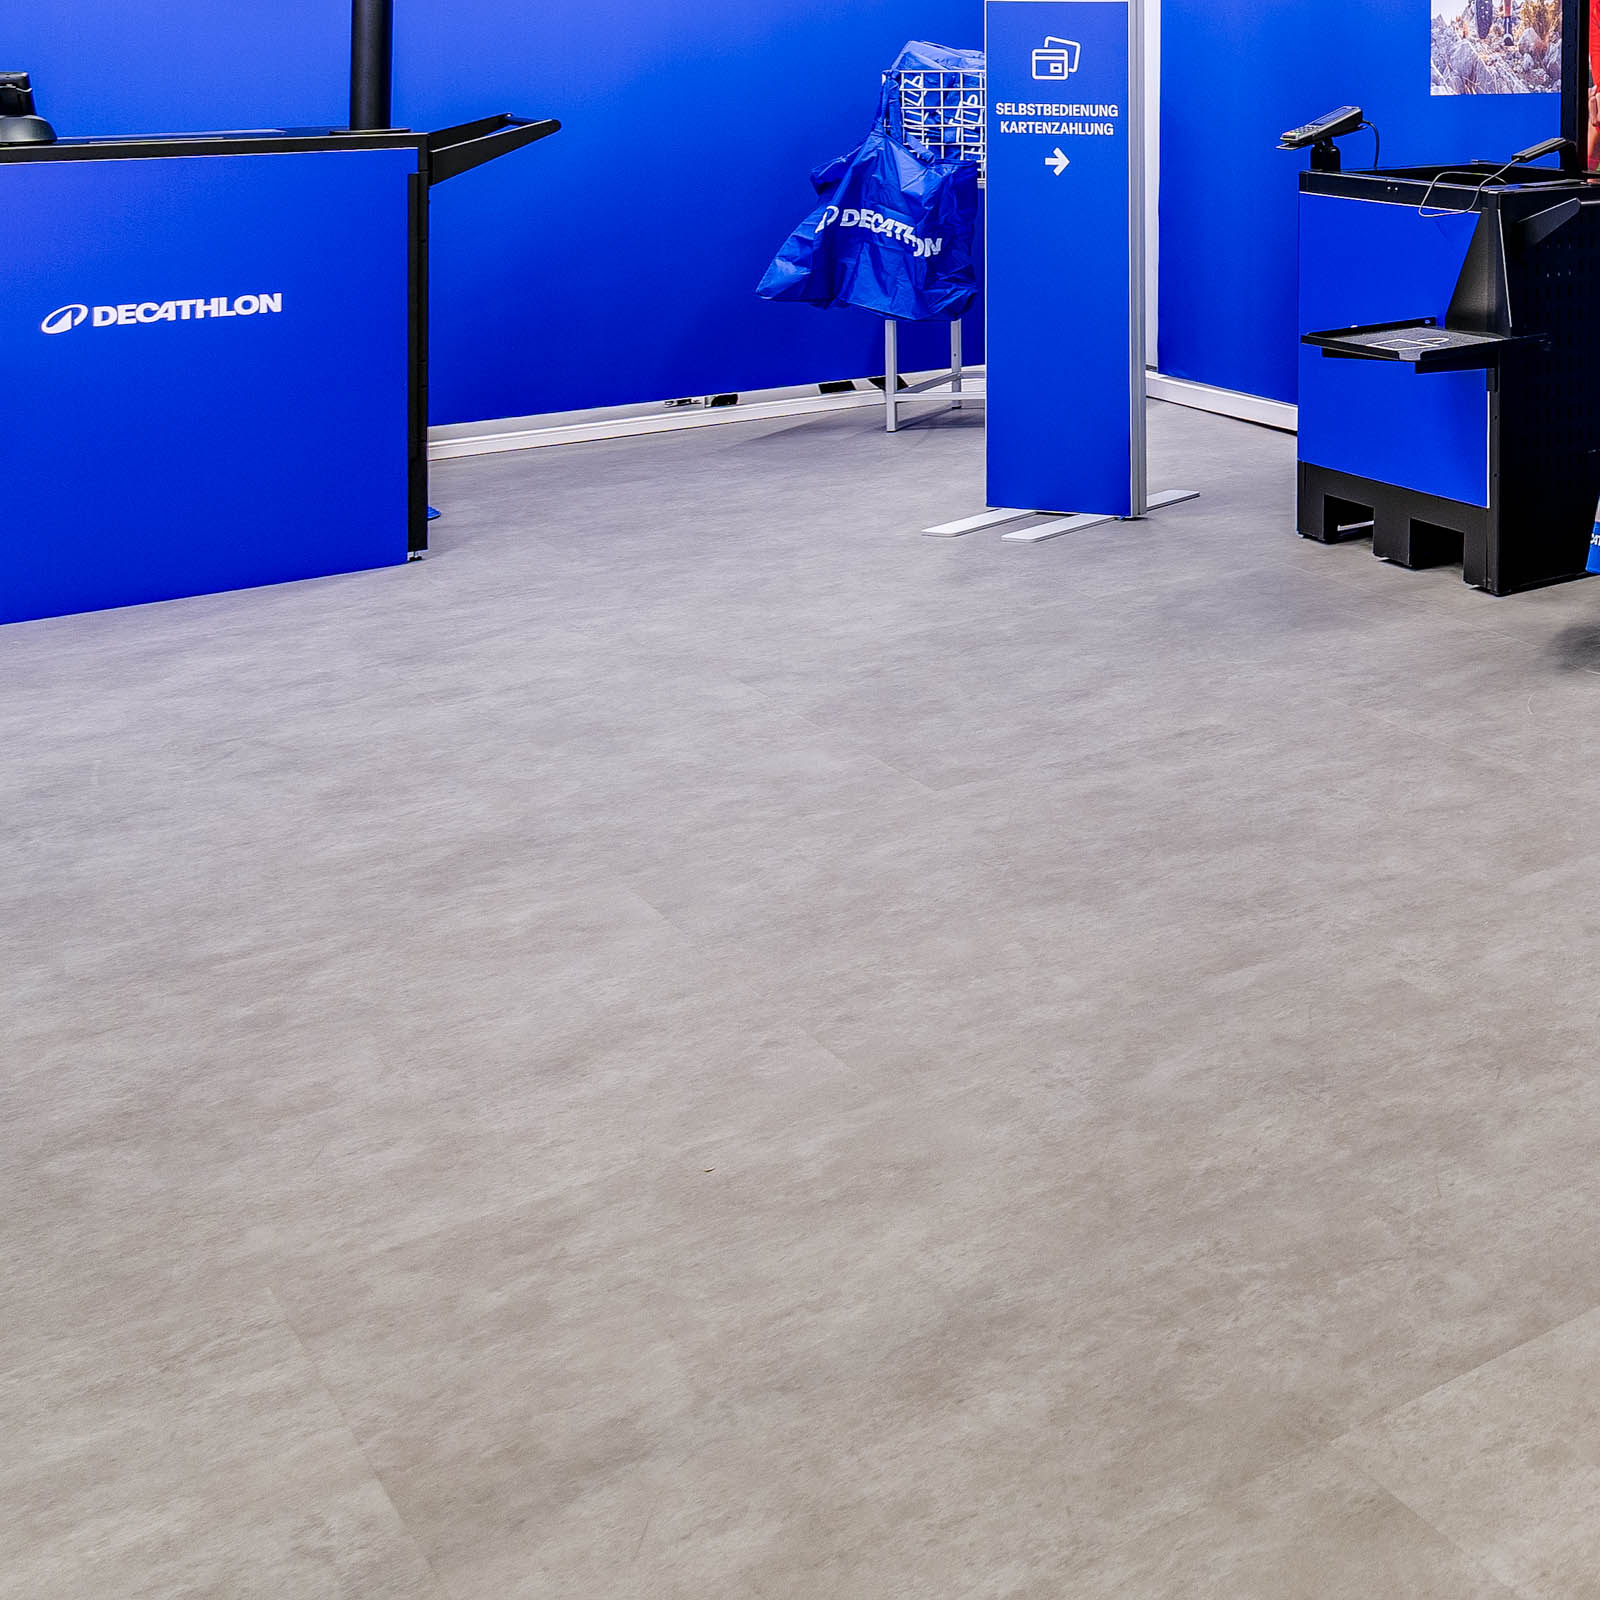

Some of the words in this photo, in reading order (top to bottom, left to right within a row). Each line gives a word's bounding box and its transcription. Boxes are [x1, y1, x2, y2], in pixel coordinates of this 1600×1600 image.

[995, 102, 1119, 118] SELBSTBEDIENUNG
[1000, 120, 1114, 136] KARTENZAHLUNG
[92, 293, 283, 328] DECATHLON
